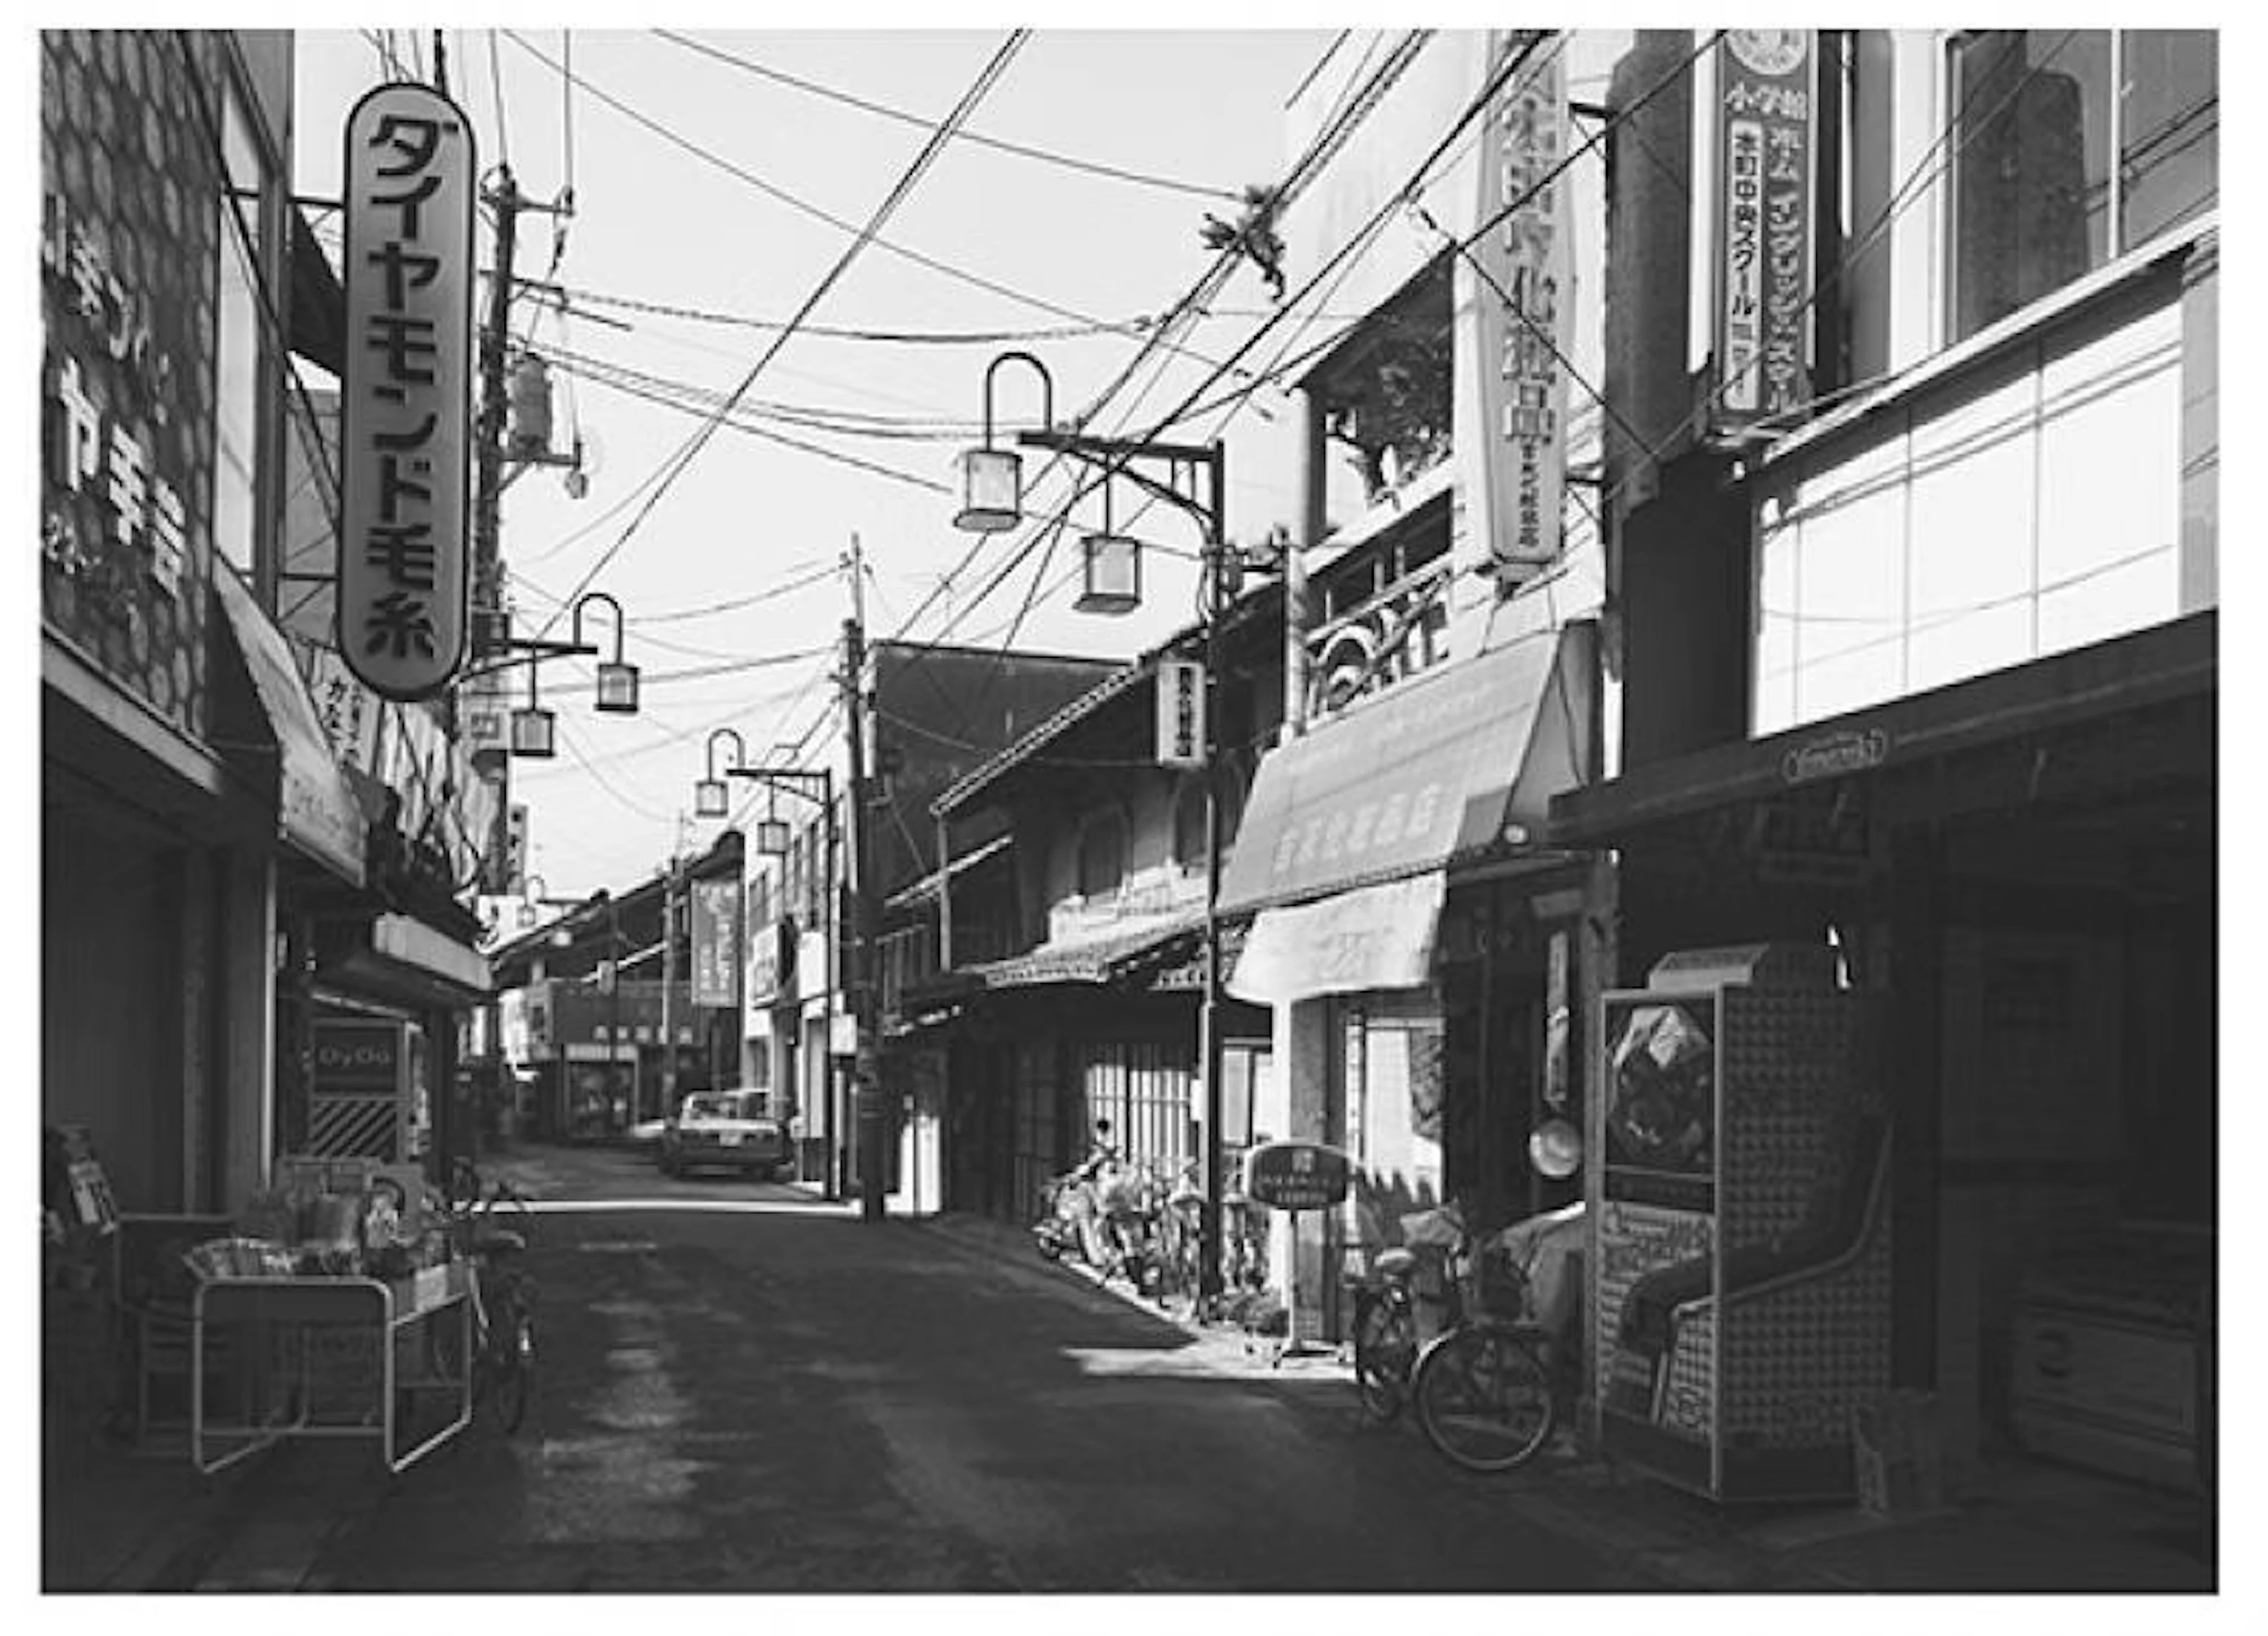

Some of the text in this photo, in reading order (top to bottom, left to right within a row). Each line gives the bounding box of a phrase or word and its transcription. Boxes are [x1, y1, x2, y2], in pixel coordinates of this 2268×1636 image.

[1723, 81, 1807, 120] 小学館
[366, 115, 460, 660] ダイヤモンド毛糸
